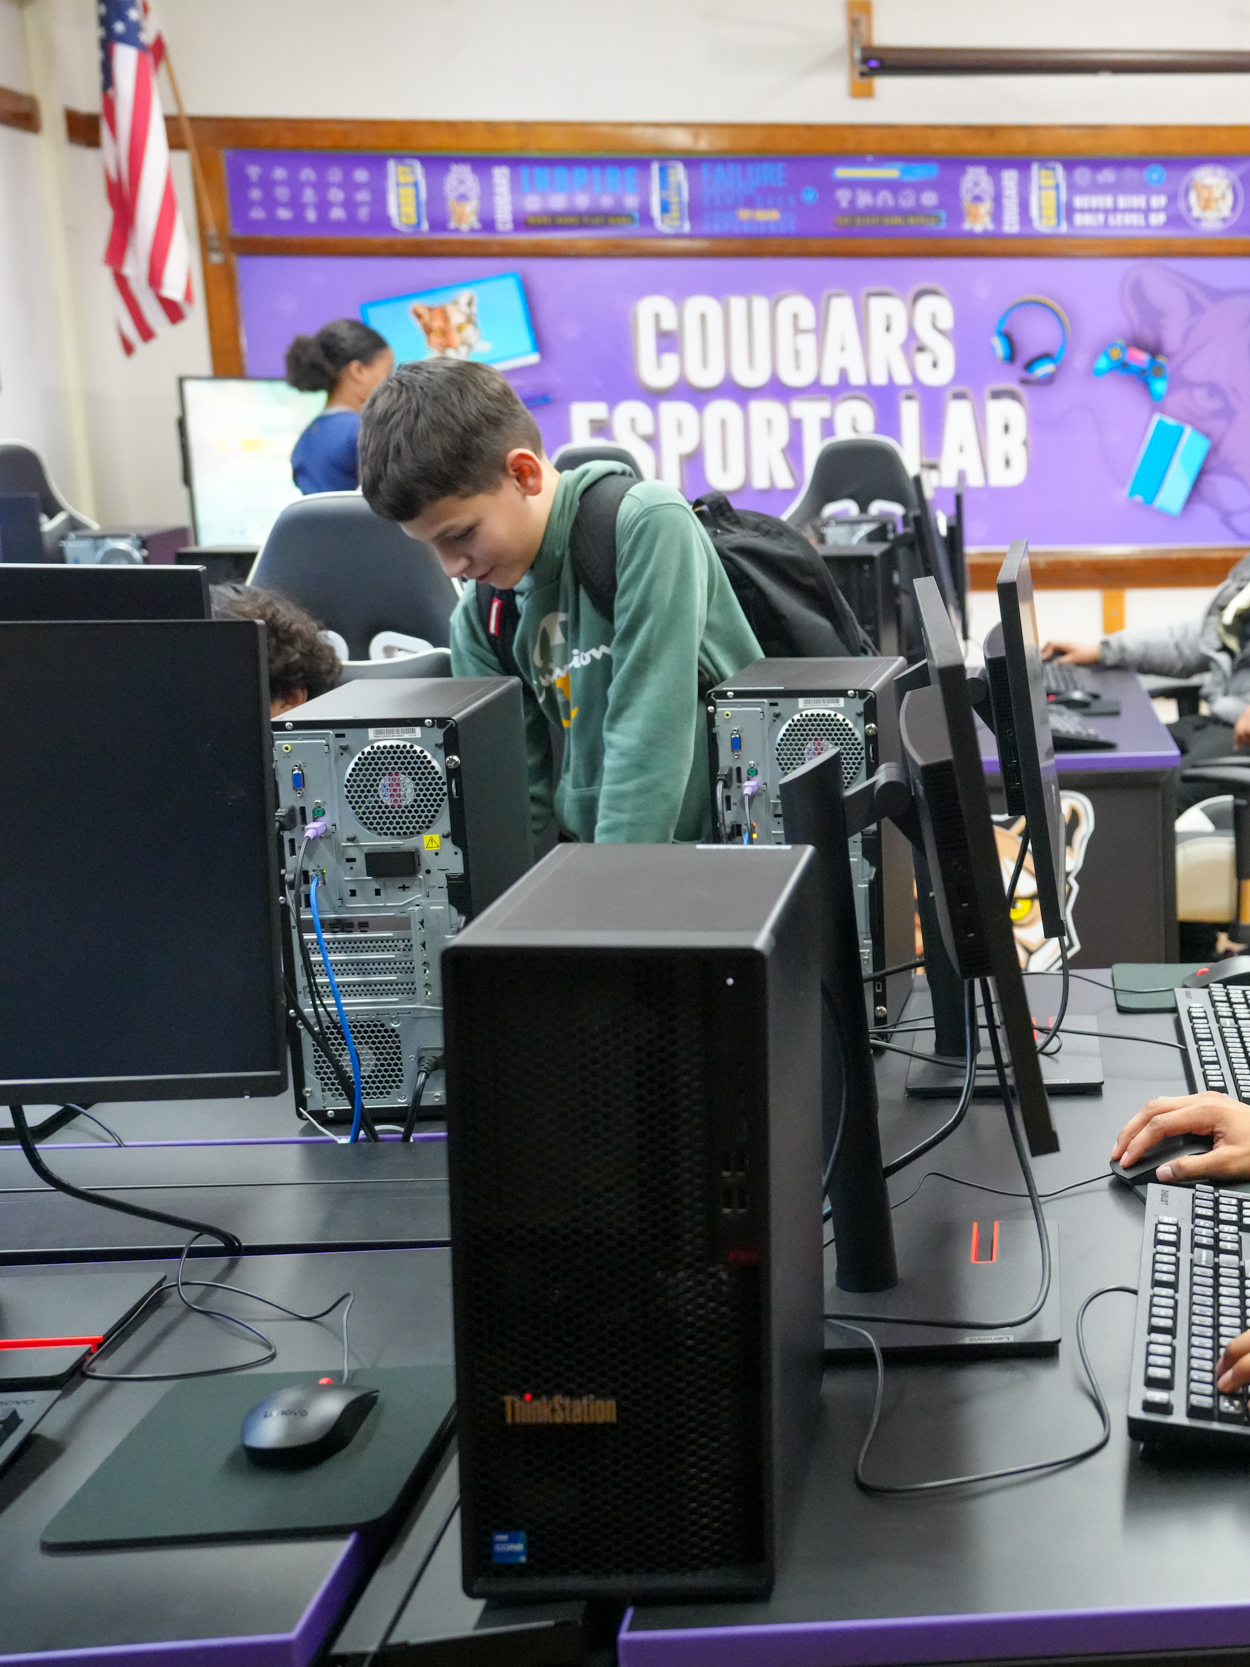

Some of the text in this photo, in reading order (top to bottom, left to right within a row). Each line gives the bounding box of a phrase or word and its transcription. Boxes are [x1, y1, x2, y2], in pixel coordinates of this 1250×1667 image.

[521, 166, 639, 193] INSPIRE
[1072, 194, 1168, 209] NEVER GIVE UP
[1073, 211, 1167, 227] ONLY LEVEL UP
[634, 288, 956, 390] COUGARS
[900, 397, 1028, 488] LAB
[504, 1393, 617, 1424] ThinkStation
